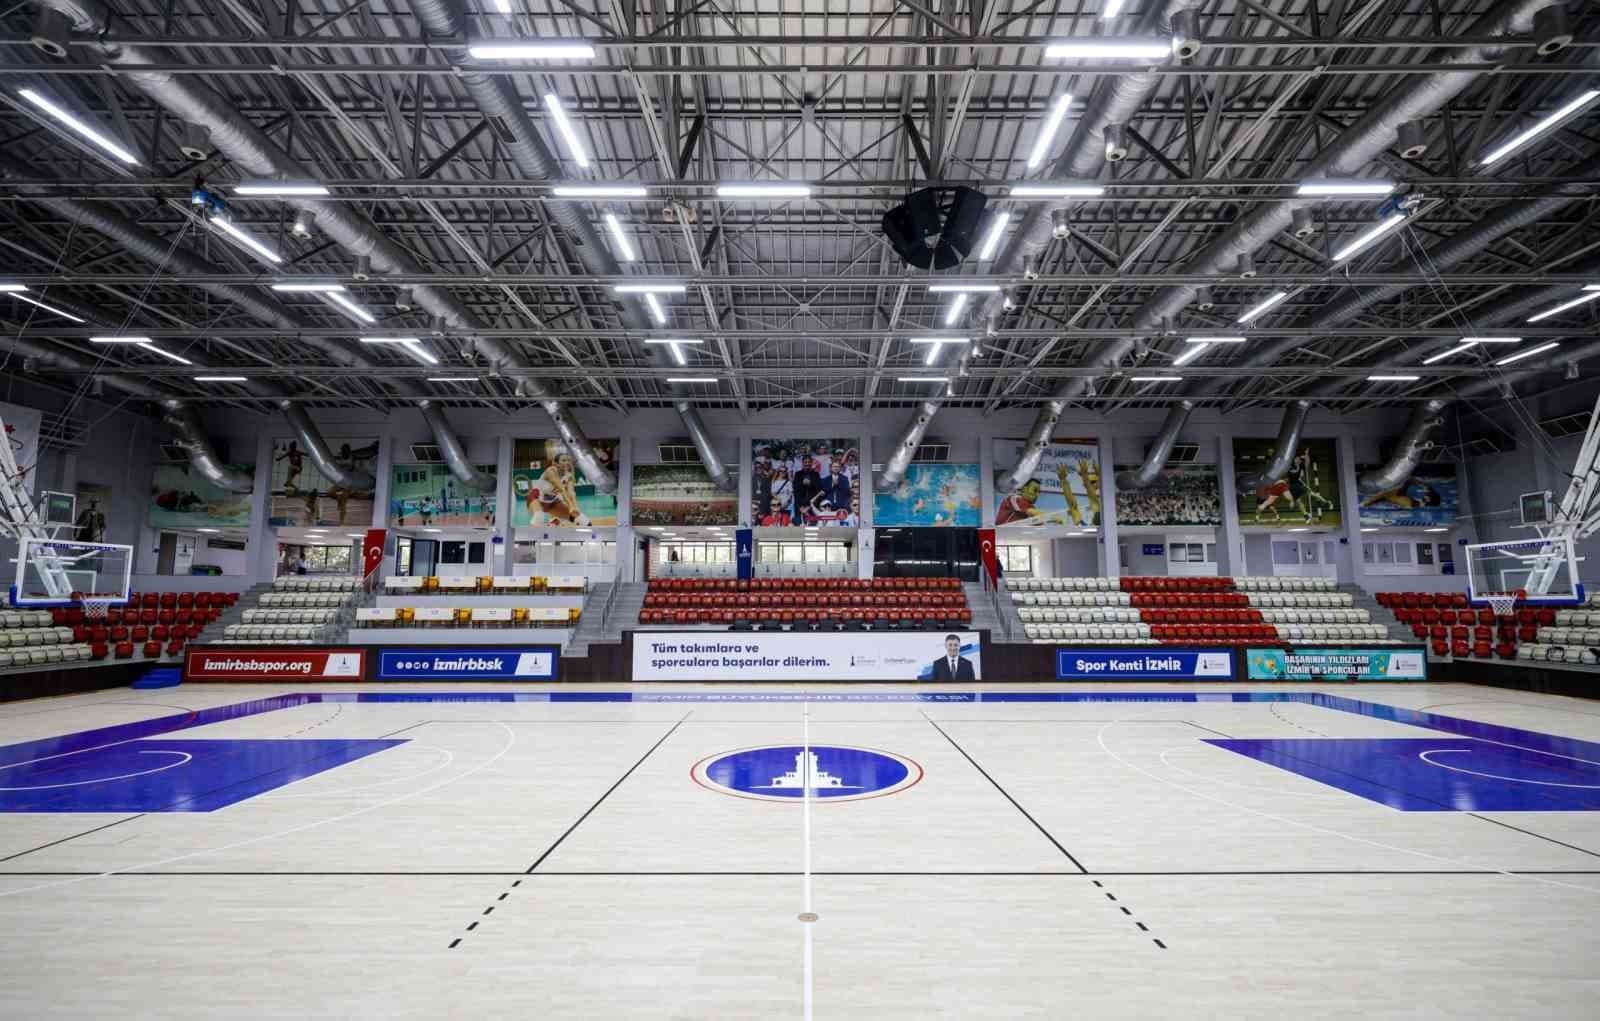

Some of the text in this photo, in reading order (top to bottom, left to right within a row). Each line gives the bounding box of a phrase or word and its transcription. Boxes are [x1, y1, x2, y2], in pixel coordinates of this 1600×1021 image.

[651, 642, 760, 653] Tüm takımlara ve
[204, 659, 312, 673] izmirbsbspor.org
[433, 657, 503, 671] izmirbbsk
[651, 656, 830, 669] sporculara başarılar dilerim.
[1076, 656, 1181, 673] Spor Kenti İZMİR
[1328, 655, 1370, 664] YILDIZLARI
[1323, 664, 1371, 674] SPORCULARI
